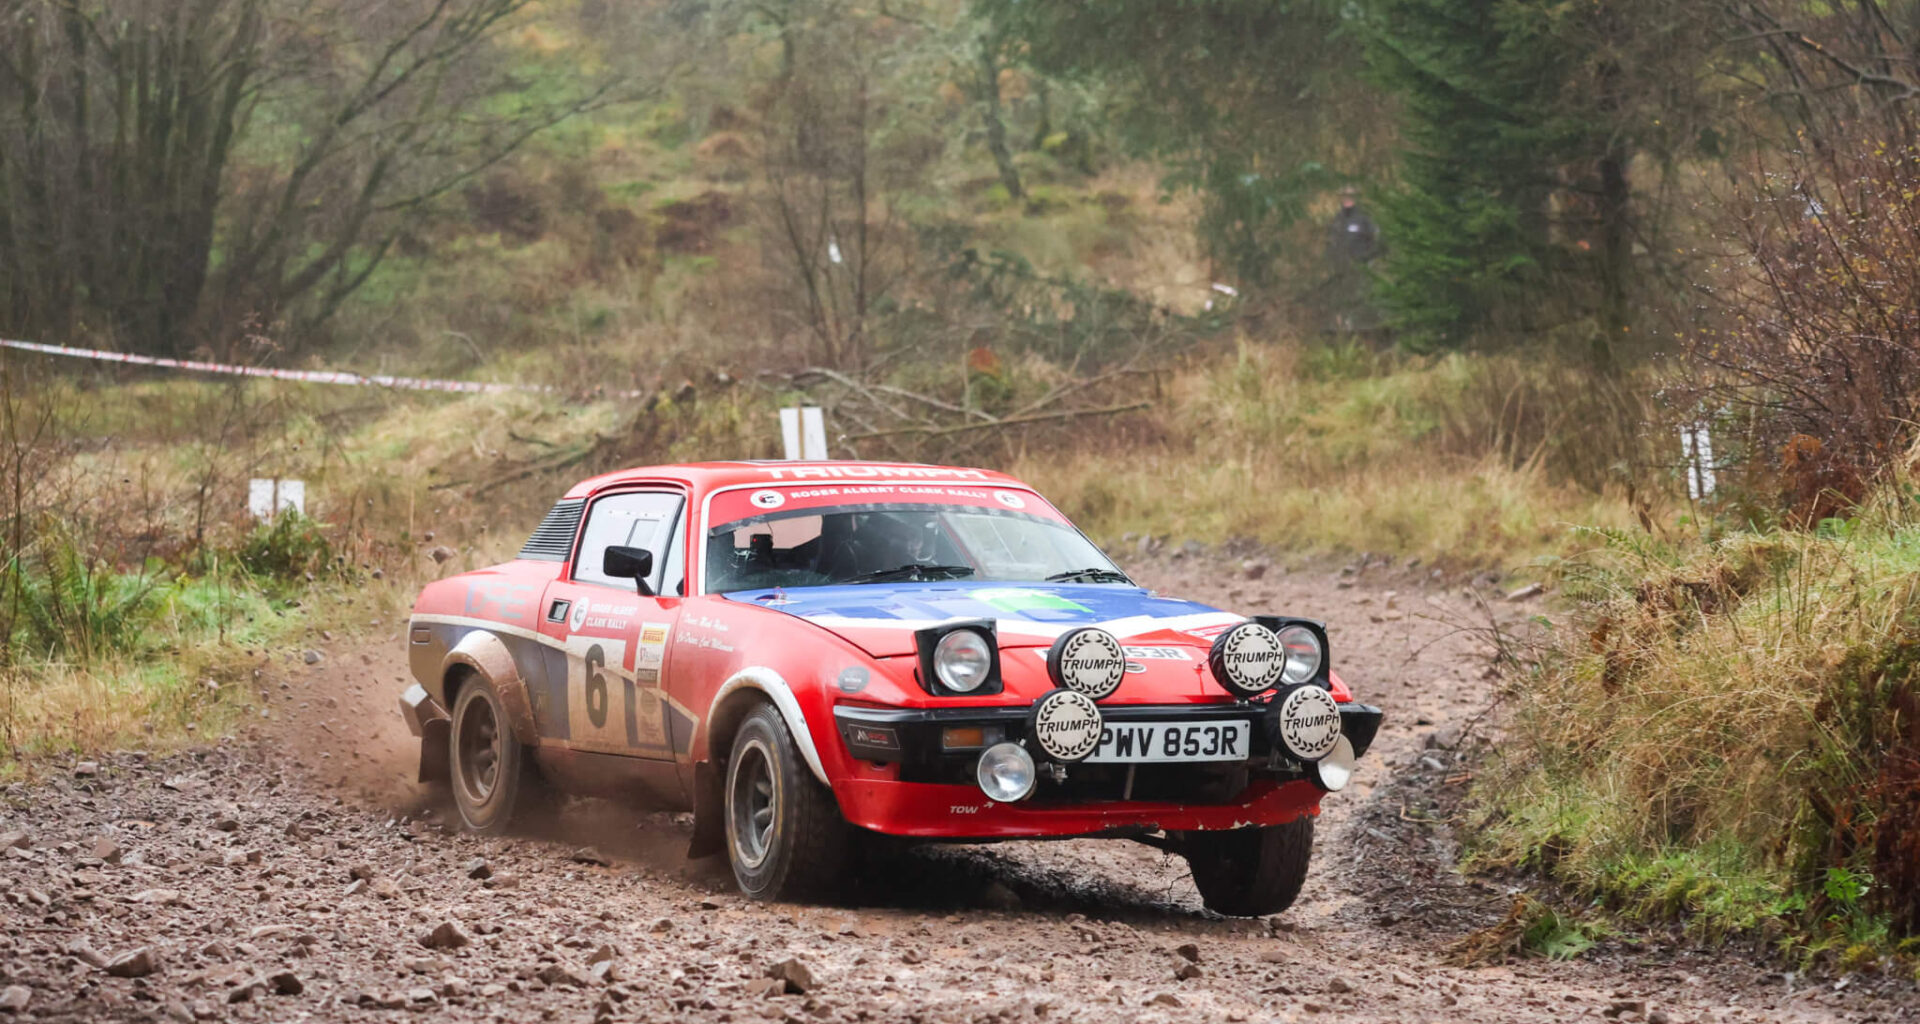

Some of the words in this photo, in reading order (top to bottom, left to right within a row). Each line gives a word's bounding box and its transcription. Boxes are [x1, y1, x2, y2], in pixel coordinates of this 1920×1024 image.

[757, 466, 989, 479] TRIUMPH
[790, 488, 840, 499] ROGER
[843, 486, 895, 495] ALBERT
[899, 486, 945, 495] CLARK
[947, 488, 988, 499] RALLY
[1125, 647, 1182, 659] 53R
[1226, 651, 1282, 664] TRIUMPH
[1063, 659, 1121, 670] TRIUMPH
[585, 643, 608, 729] 6
[1038, 719, 1099, 733] TRIUMPH
[1284, 714, 1340, 730] TRIUMPH
[1094, 728, 1153, 757] PWV
[1163, 726, 1238, 757] 853R
[950, 806, 978, 814] TOW
